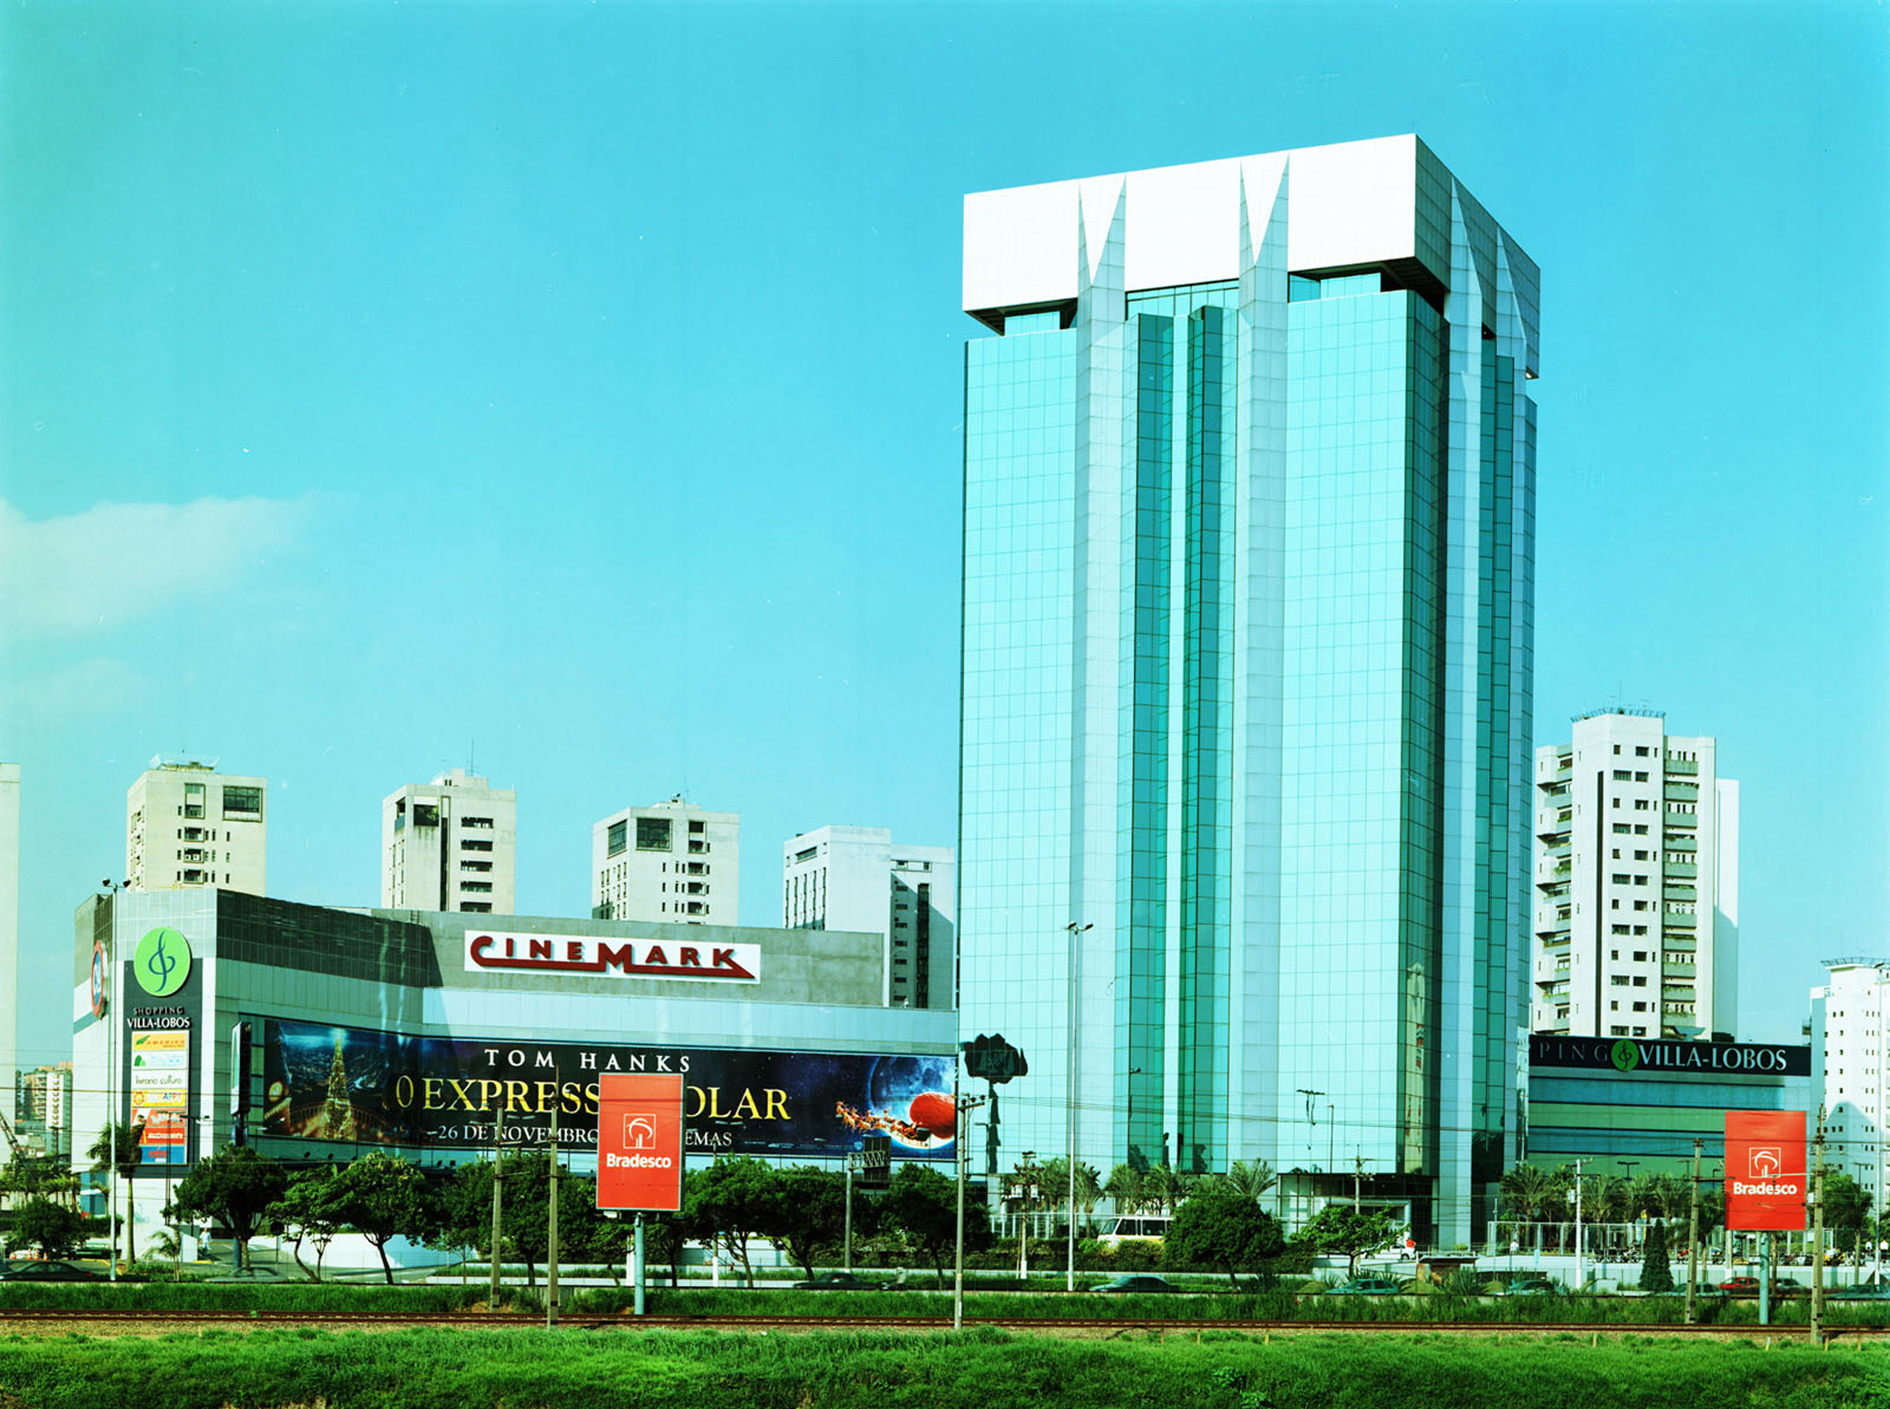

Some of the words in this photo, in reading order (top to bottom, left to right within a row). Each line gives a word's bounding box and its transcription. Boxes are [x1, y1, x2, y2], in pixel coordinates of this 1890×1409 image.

[470, 936, 756, 979] CINEMARK
[133, 1005, 184, 1016] SHOPPING
[127, 1016, 191, 1029] VILLA-LOBOS
[484, 1049, 556, 1068] TOM
[580, 1052, 691, 1073] HANKS
[1540, 1043, 1608, 1063] PING
[1639, 1044, 1787, 1071] VILLA-LOBOS
[422, 1077, 600, 1115] EXPRESS
[685, 1085, 791, 1121] OLAR
[464, 1125, 488, 1140] DE
[494, 1126, 599, 1144] NOVEMBRO
[685, 1131, 732, 1147] EMAS
[606, 1152, 672, 1169] Bradesco
[1733, 1182, 1797, 1196] Bradesco
